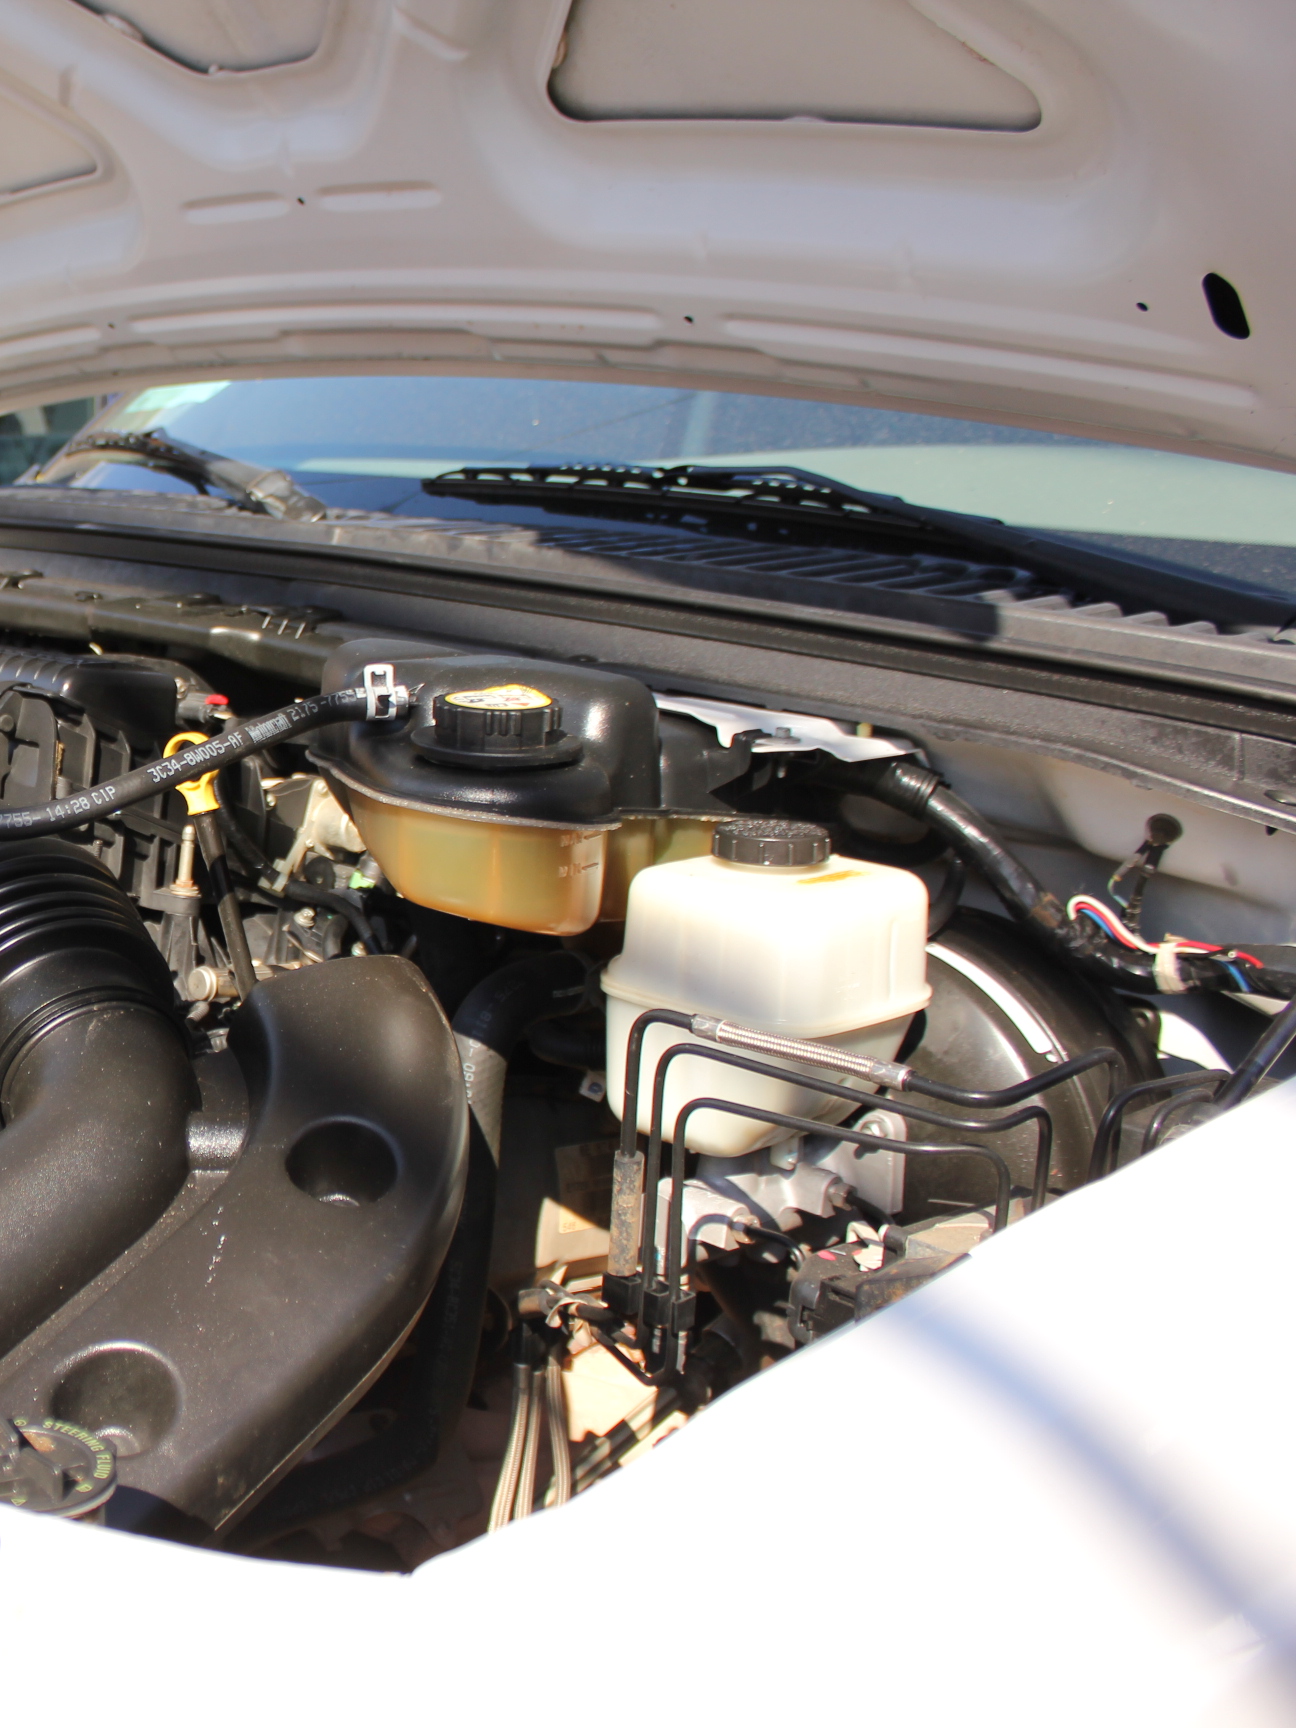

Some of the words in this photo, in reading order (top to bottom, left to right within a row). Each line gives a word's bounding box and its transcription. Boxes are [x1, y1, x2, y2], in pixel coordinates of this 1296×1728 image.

[45, 797, 91, 822] 14:28
[91, 785, 117, 806] CIP
[146, 731, 245, 784] 3C34-8W005-AF
[286, 701, 319, 722] 2175
[42, 1421, 105, 1452] STEERING
[93, 1454, 111, 1479] FLUID
